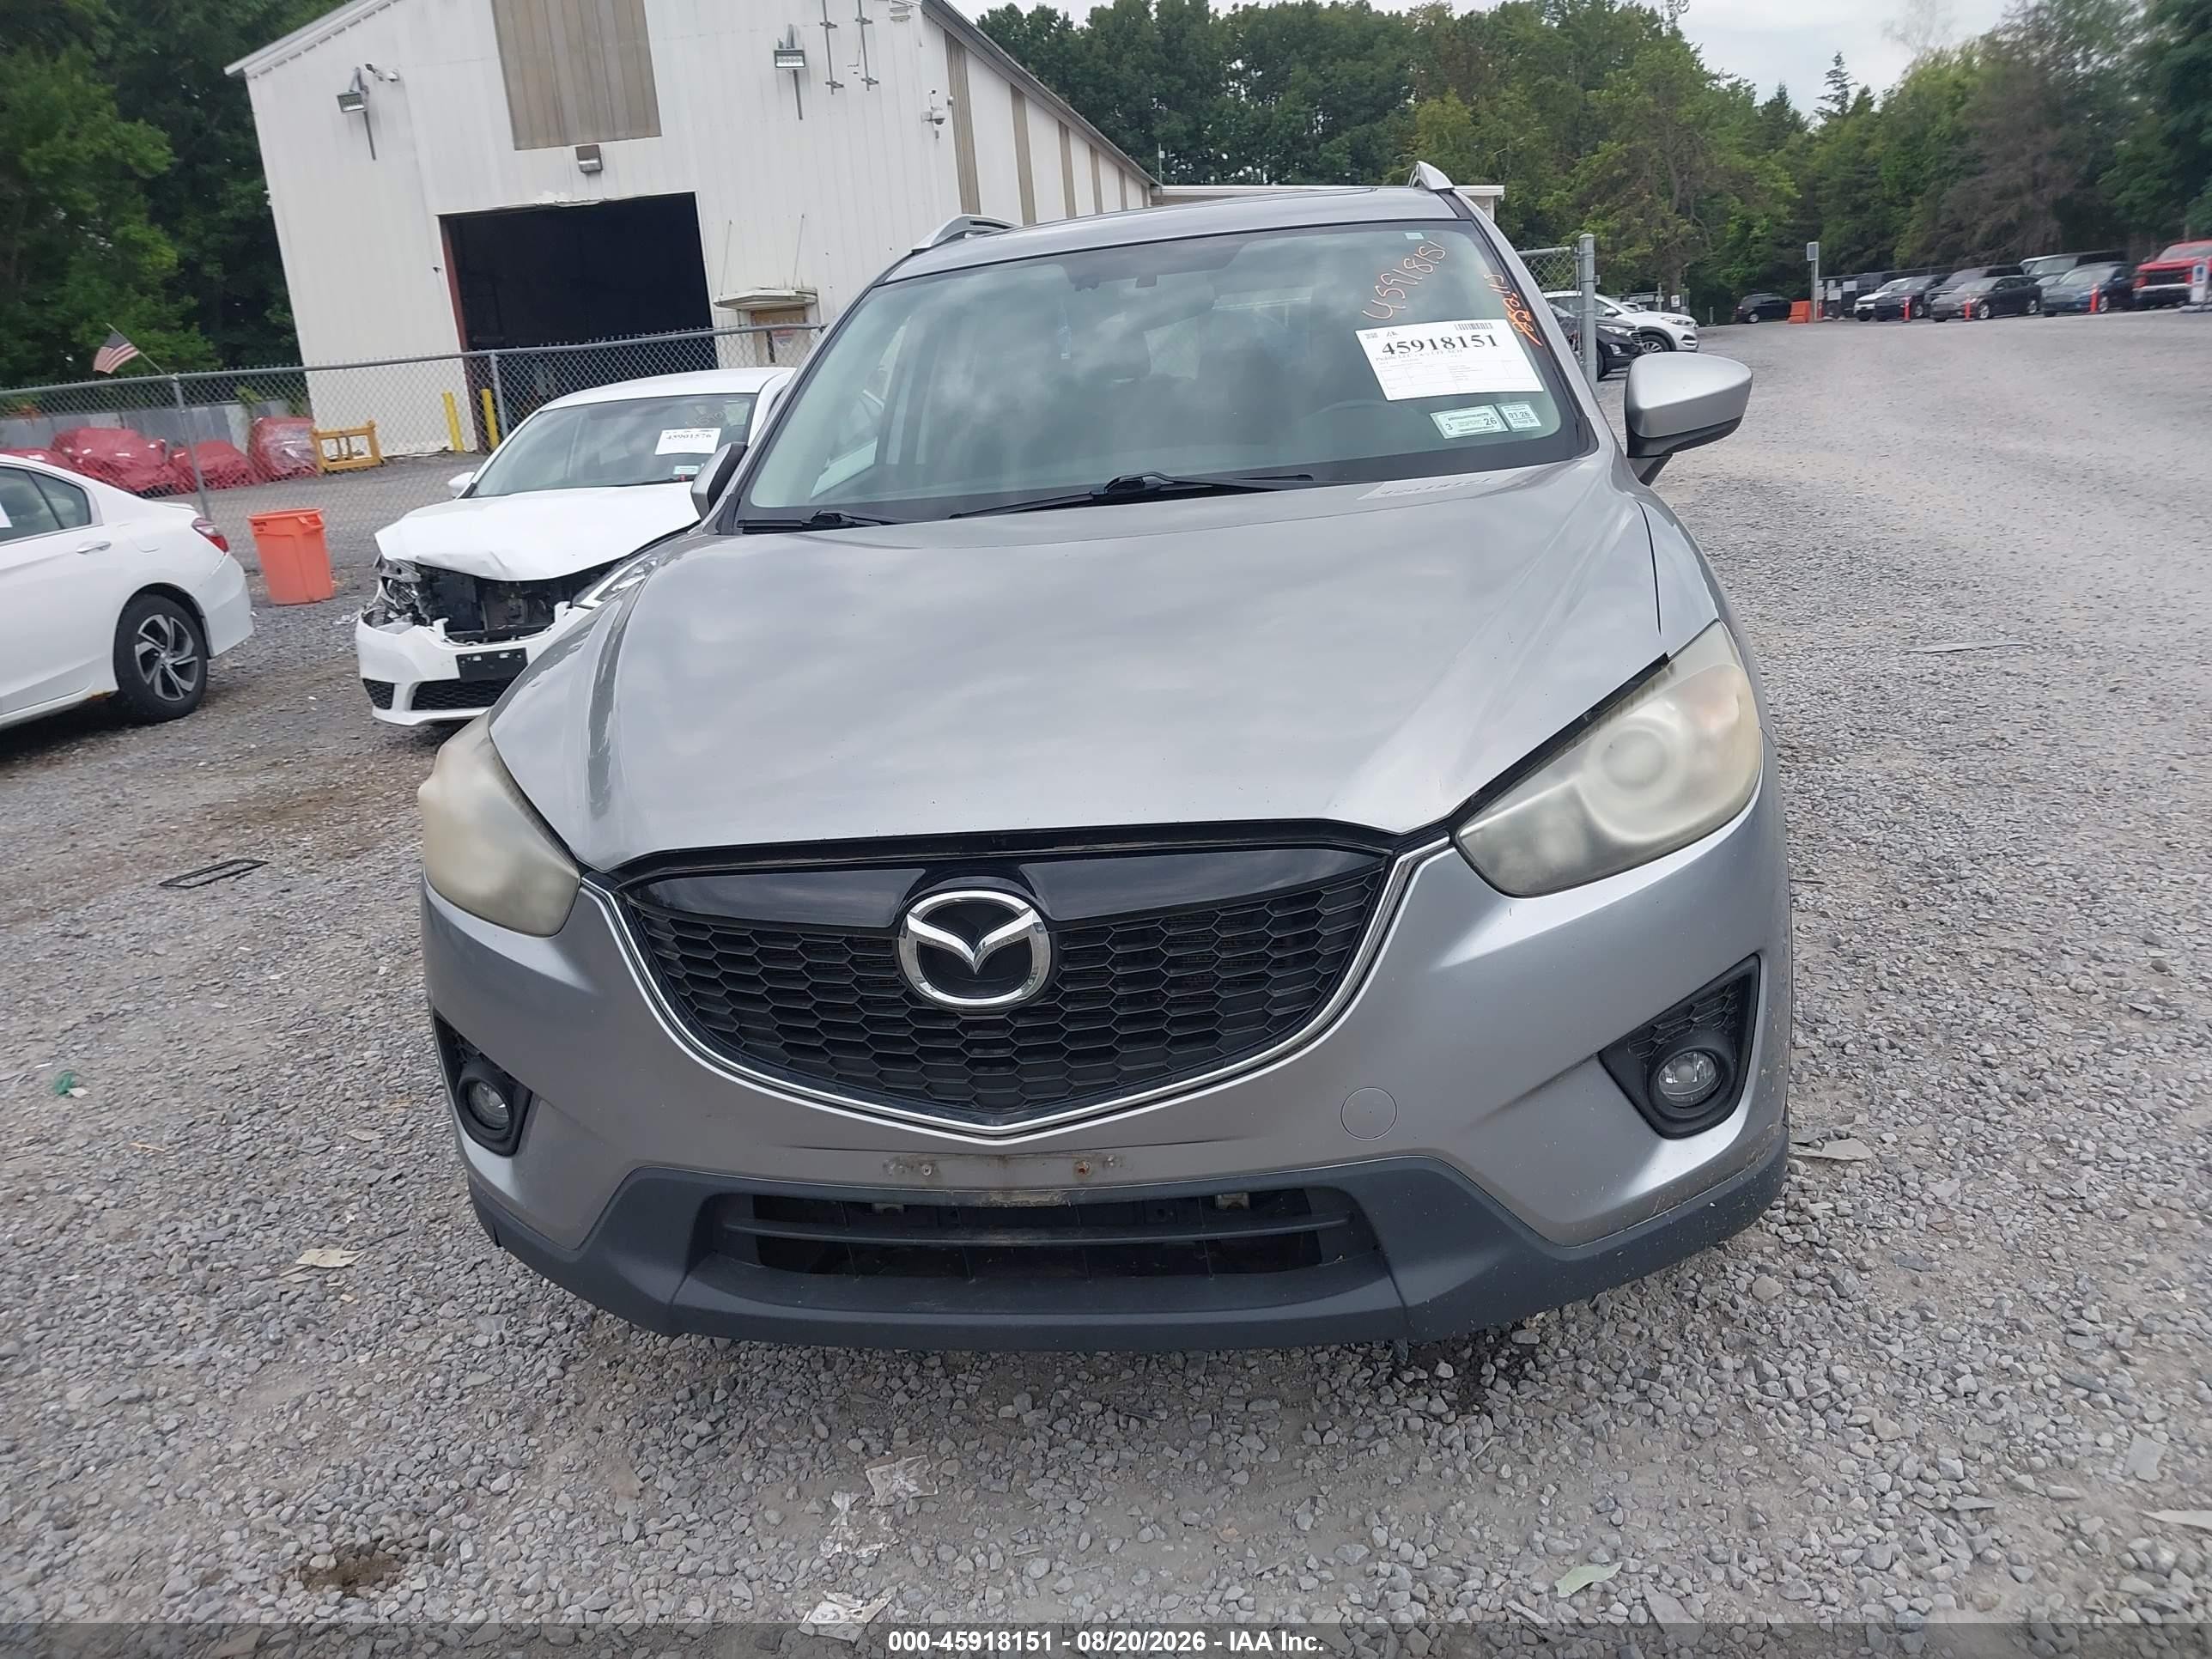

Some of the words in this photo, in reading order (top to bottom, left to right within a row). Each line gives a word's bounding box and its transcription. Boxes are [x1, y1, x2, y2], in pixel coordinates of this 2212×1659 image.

[1362, 240, 1446, 319] 45918151
[1382, 333, 1499, 355] 45918151
[1445, 422, 1454, 431] 3
[1483, 416, 1498, 426] 26
